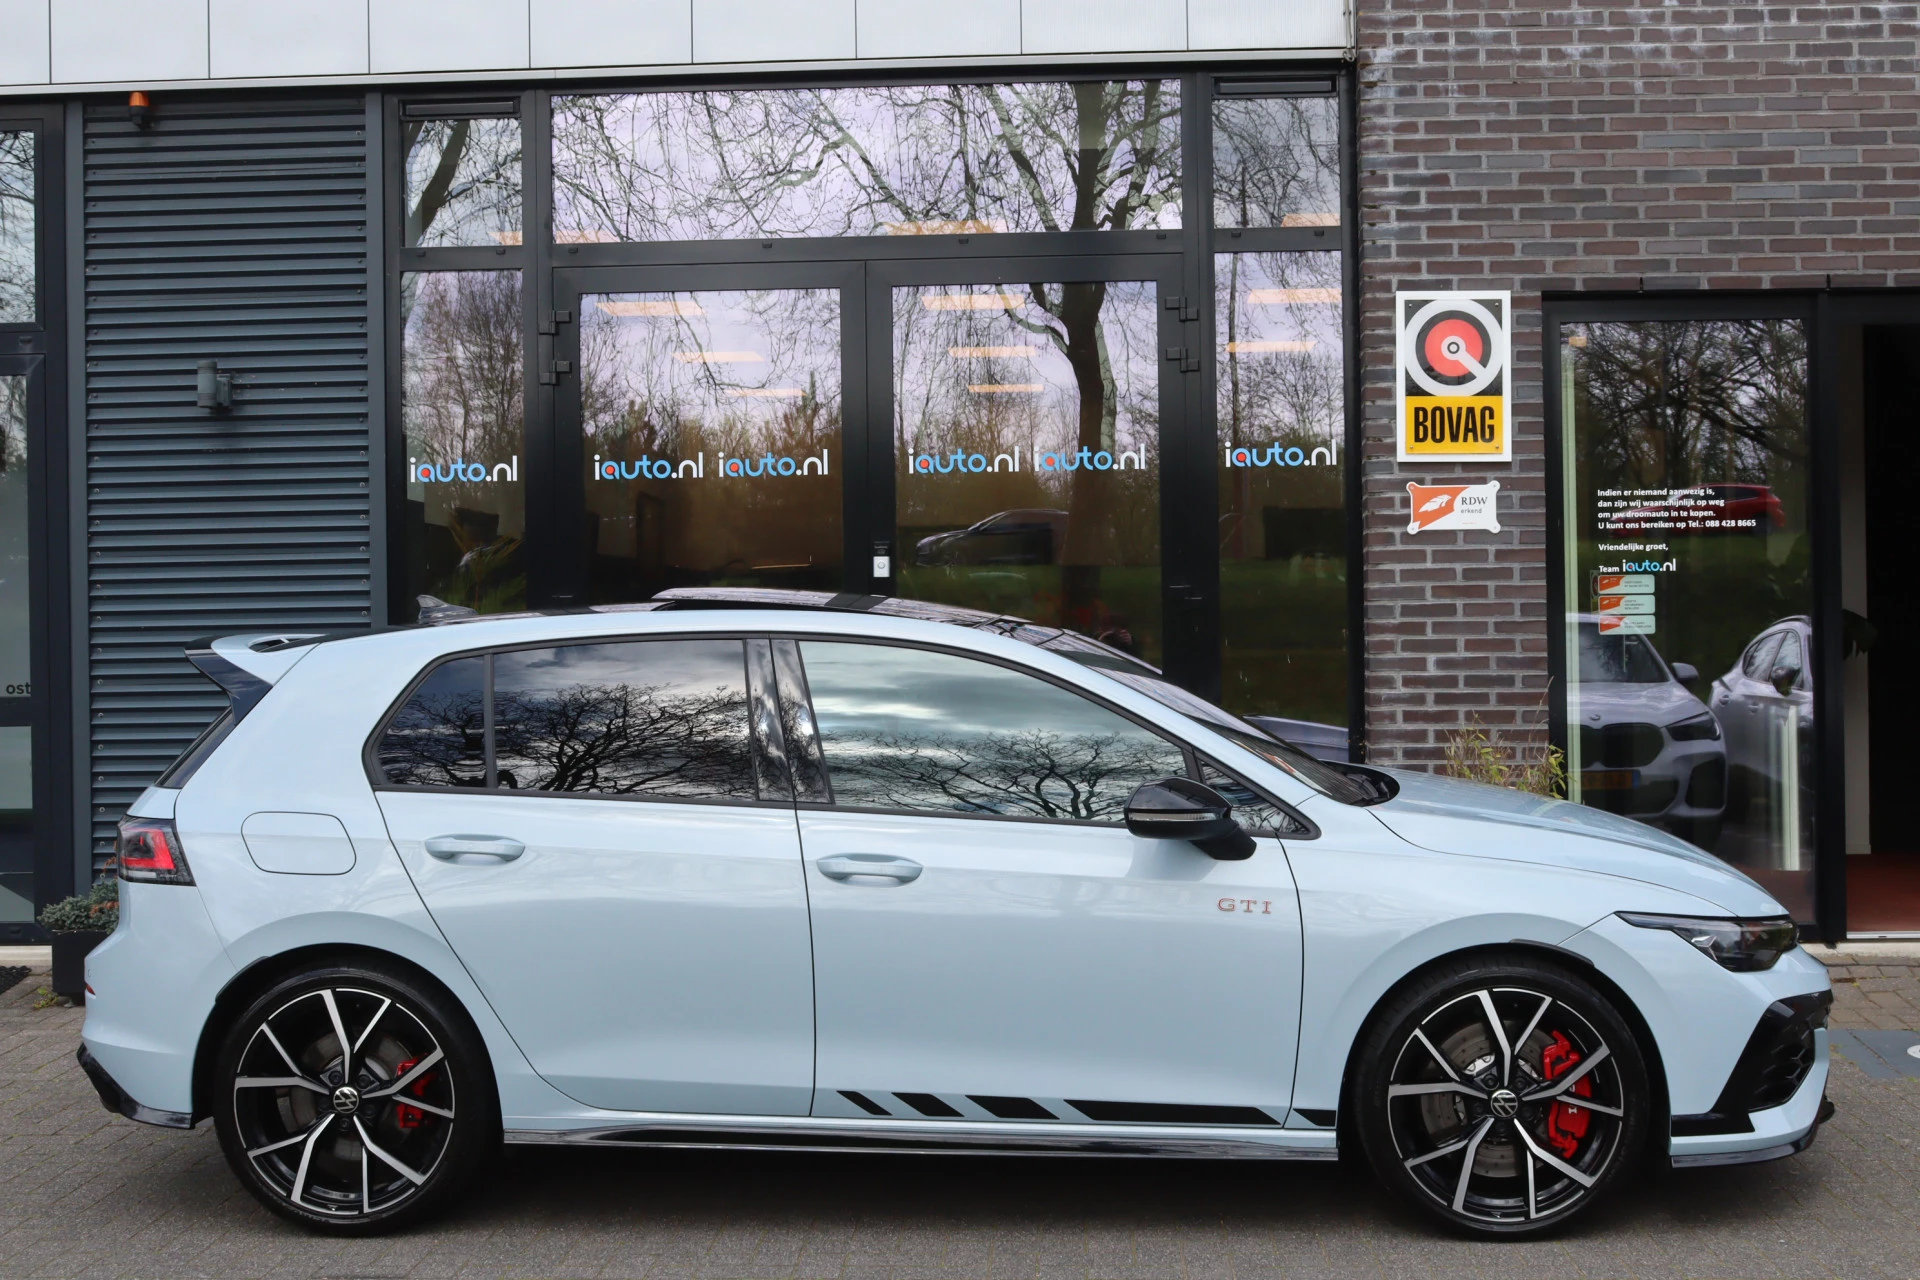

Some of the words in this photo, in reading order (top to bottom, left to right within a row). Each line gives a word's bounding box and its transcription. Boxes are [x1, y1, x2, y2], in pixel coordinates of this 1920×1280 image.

[1413, 406, 1495, 444] BOVAG
[908, 445, 1020, 475] iauto.nl
[1034, 443, 1146, 472] iauto.nl
[1225, 440, 1337, 469] iauto.nl
[410, 455, 518, 484] iauto.nl
[594, 451, 704, 481] iauto.nl
[718, 449, 829, 479] iauto.nl
[1461, 496, 1488, 506] RDW
[1597, 488, 1622, 497] Indien
[1633, 488, 1668, 496] niemand
[1669, 488, 1705, 497] aanwezig
[1706, 487, 1715, 496] is,
[1597, 500, 1613, 508] dan
[1614, 499, 1628, 509] zijn
[1629, 499, 1641, 508] wij
[1642, 498, 1695, 508] waarschijnlijk
[1696, 499, 1707, 507] op
[1708, 499, 1725, 507] weg
[1626, 510, 1670, 518] droomauto
[1689, 509, 1716, 518] kopen.
[1598, 521, 1605, 529] U
[1606, 521, 1624, 529] kunt
[1640, 520, 1675, 529] bereiken
[1675, 521, 1686, 529] op
[1687, 520, 1704, 528] Tel.:
[1705, 519, 1720, 527] 088
[1721, 519, 1736, 527] 428
[1737, 519, 1757, 527] 8665
[1598, 542, 1644, 552] Vriendelijke
[1645, 543, 1669, 552] groet,
[1599, 565, 1620, 573] Team
[1622, 558, 1677, 572] iauto.nl
[1217, 897, 1272, 915] GTI
